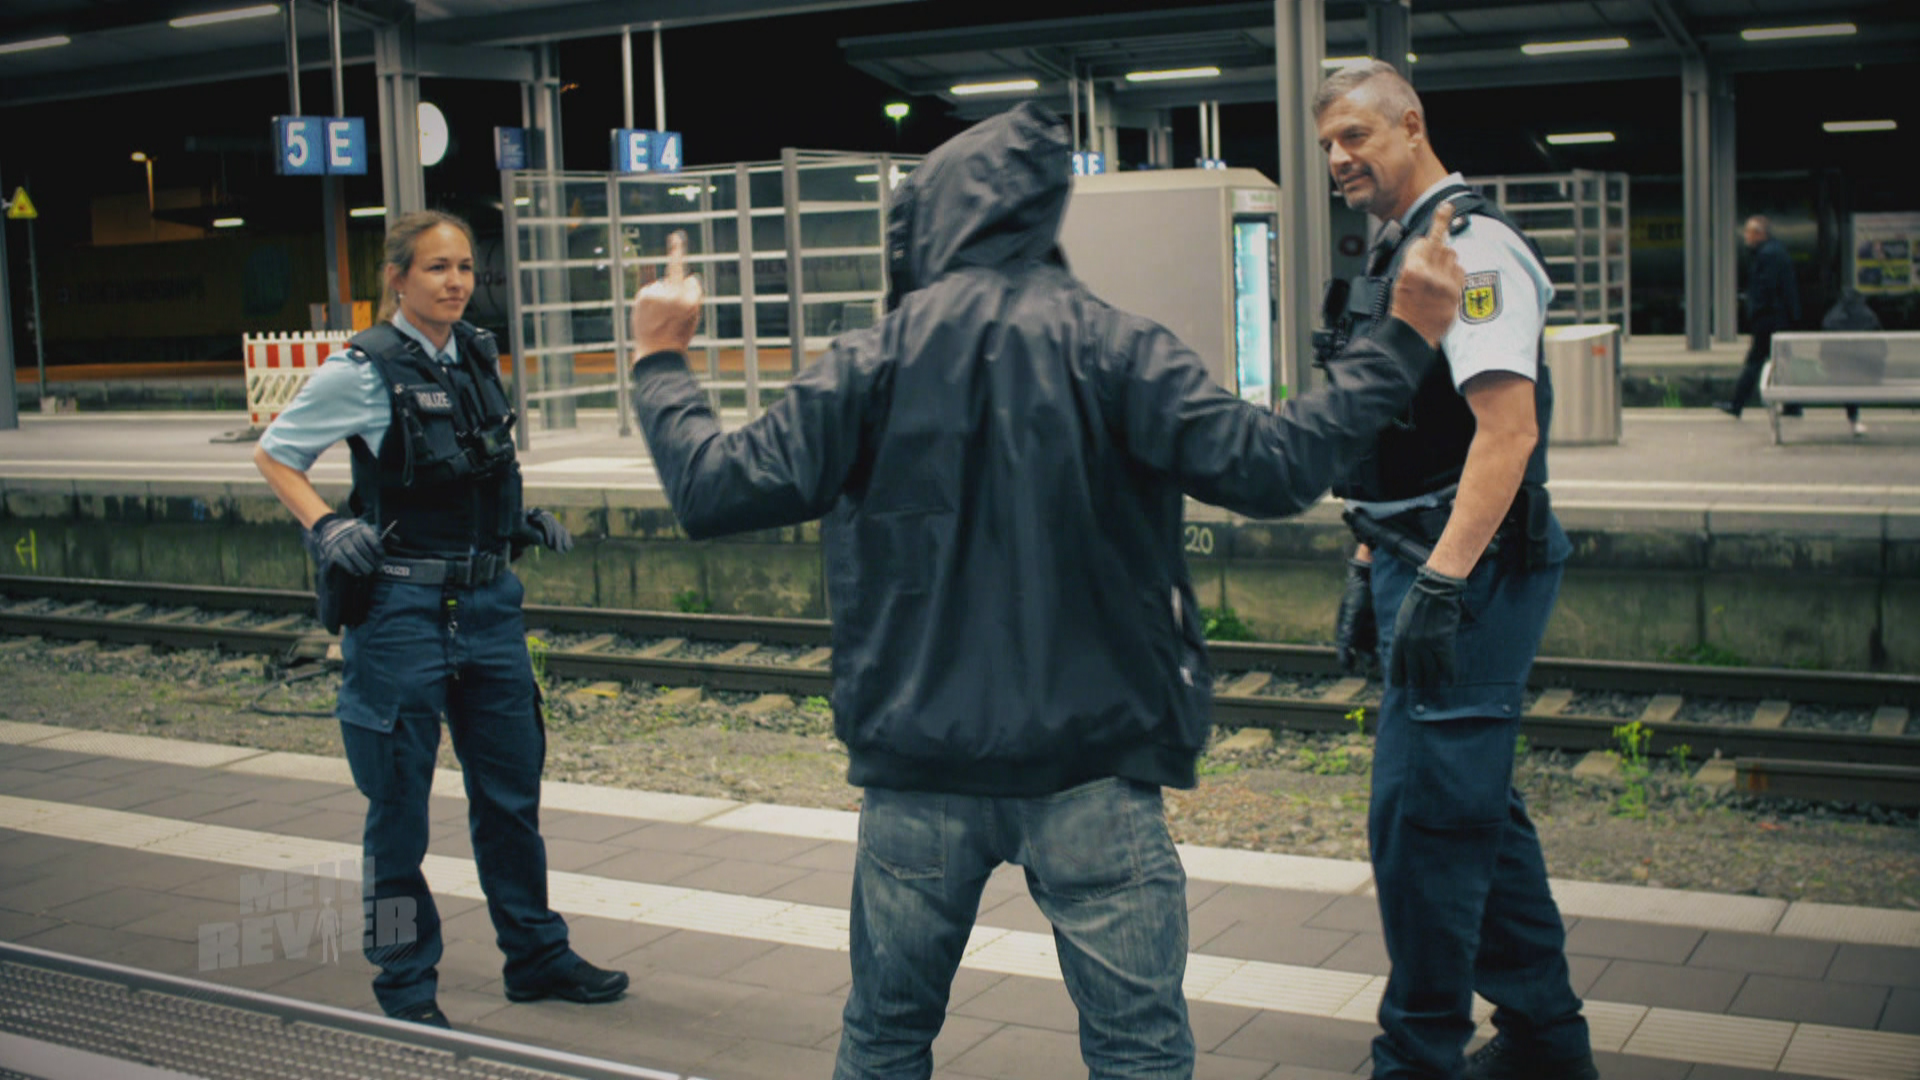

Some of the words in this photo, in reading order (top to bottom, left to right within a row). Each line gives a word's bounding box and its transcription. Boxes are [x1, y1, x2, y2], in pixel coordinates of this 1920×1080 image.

[287, 121, 308, 167] 5
[328, 121, 352, 166] E
[630, 132, 648, 171] E
[661, 136, 679, 171] 4
[1184, 525, 1214, 555] 20
